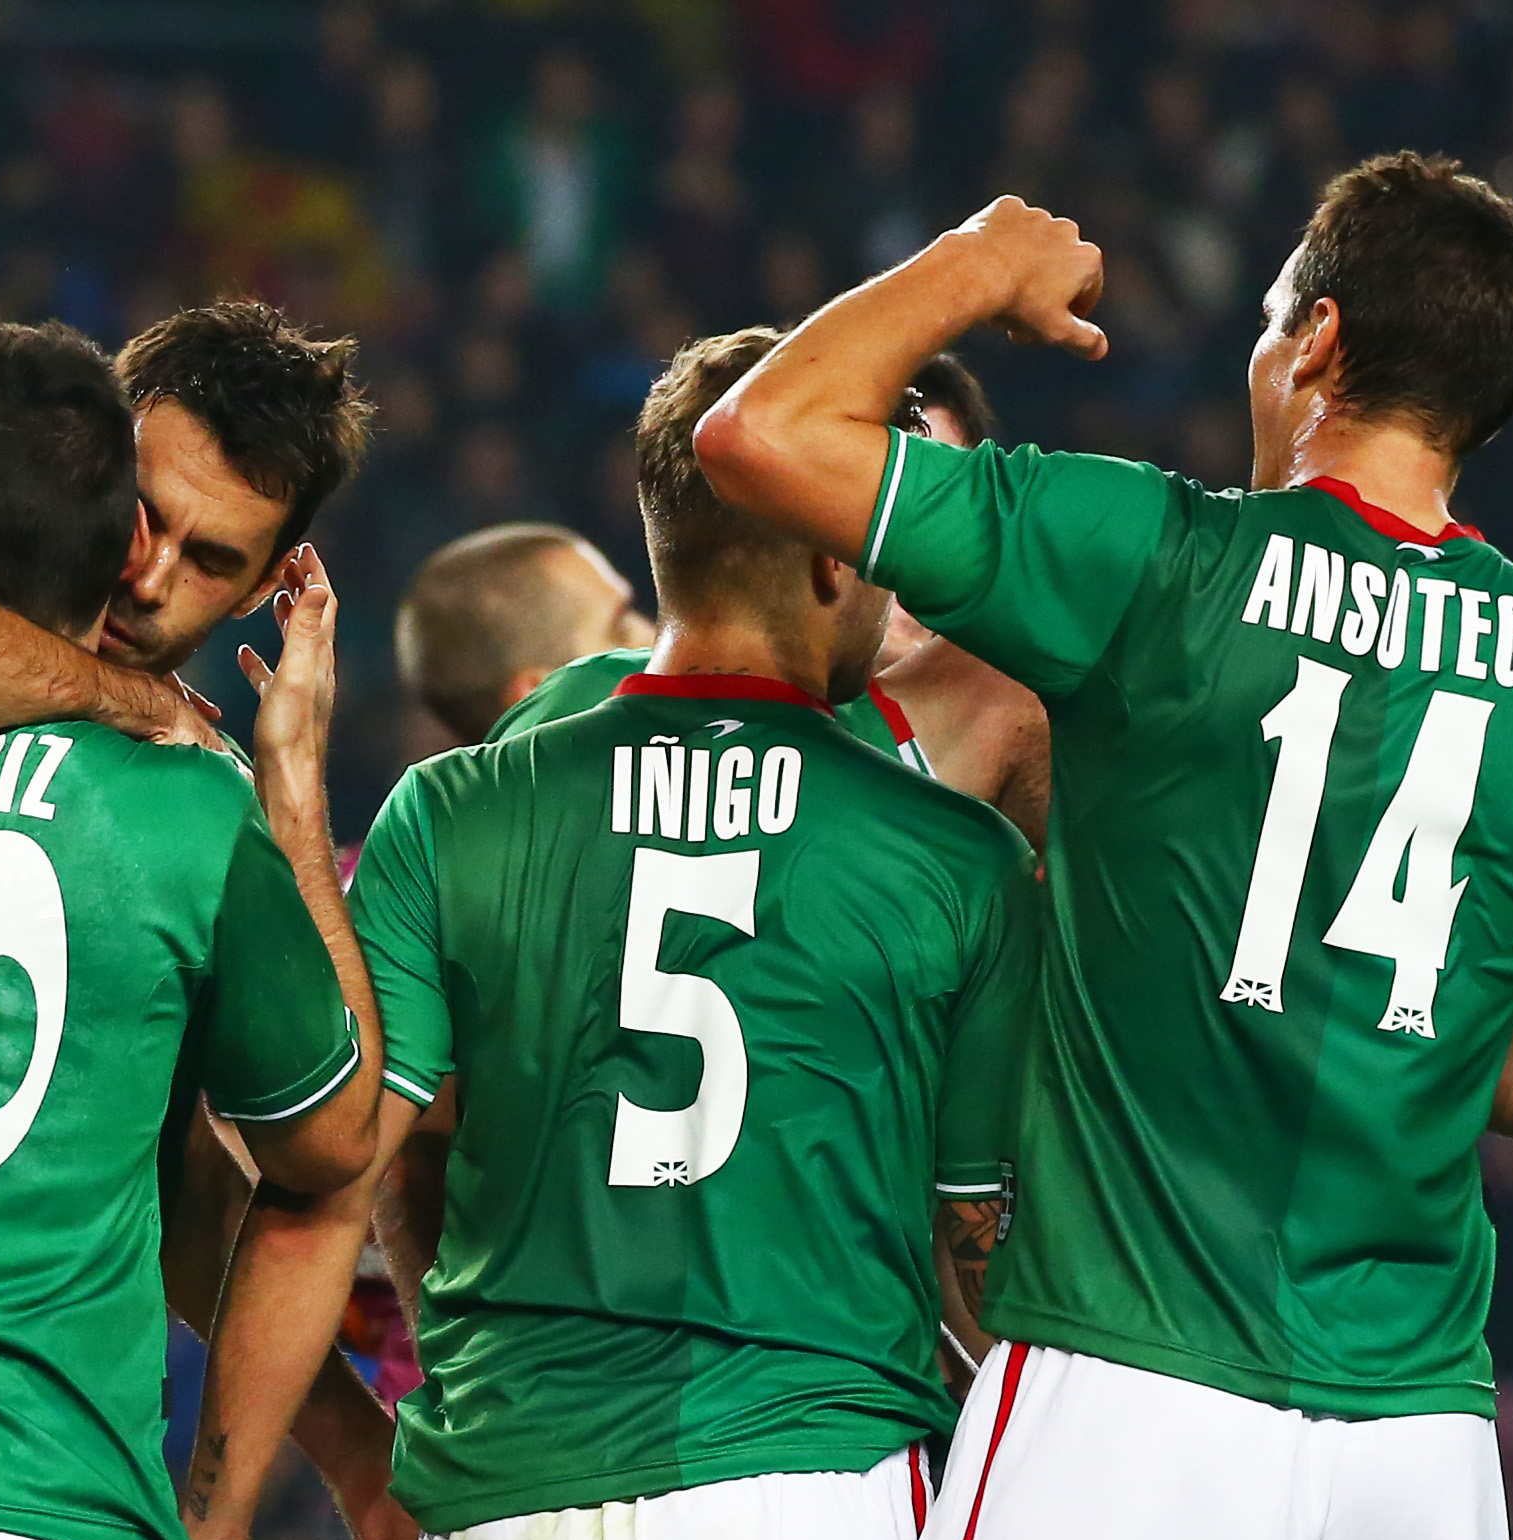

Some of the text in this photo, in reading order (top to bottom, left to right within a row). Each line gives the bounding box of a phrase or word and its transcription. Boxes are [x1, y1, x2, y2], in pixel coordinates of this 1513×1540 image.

[610, 735, 803, 842] IÑIGO
[1219, 654, 1496, 1039] 14
[607, 846, 761, 1187] 5
